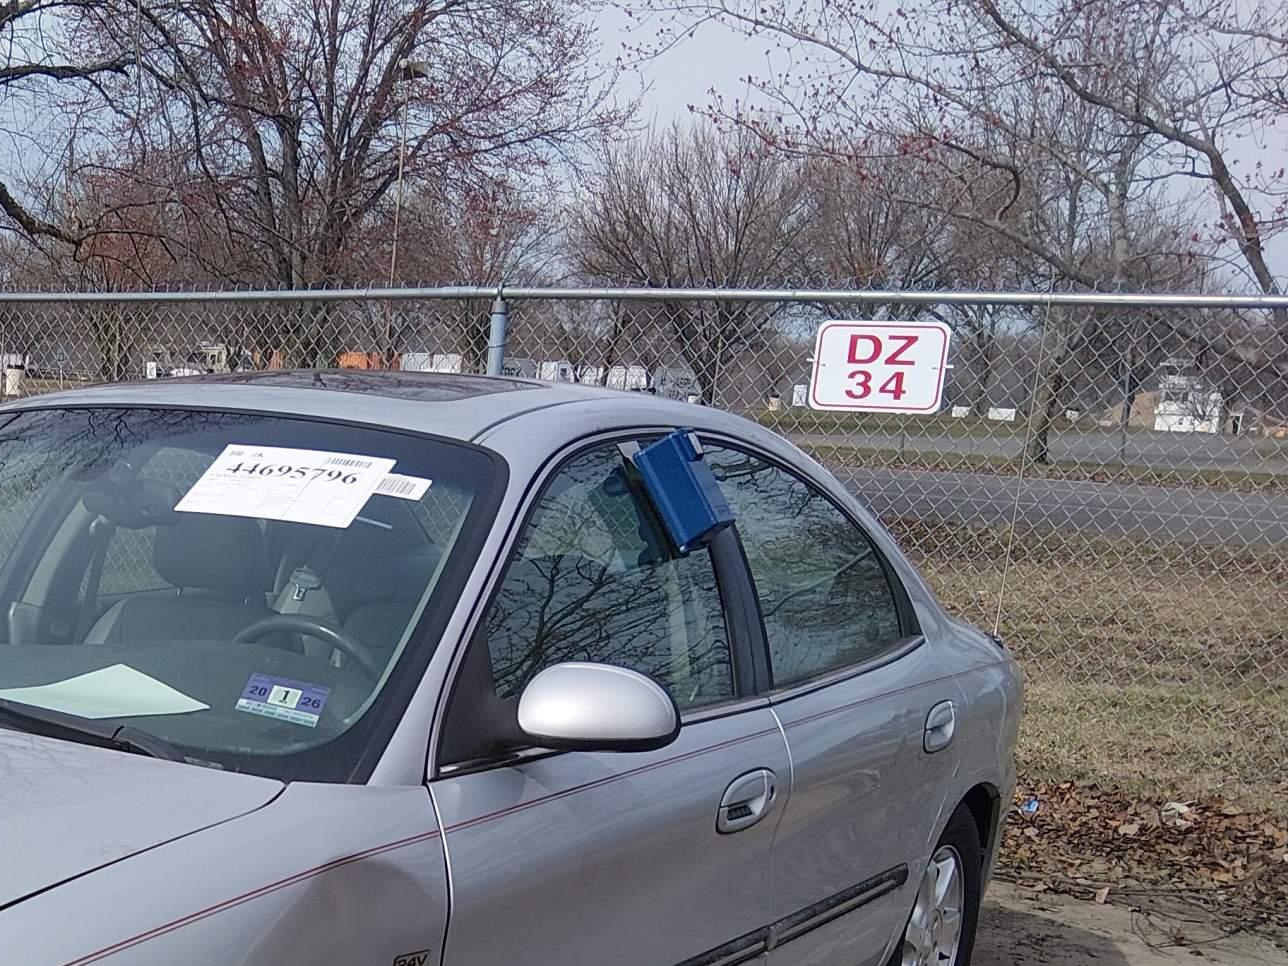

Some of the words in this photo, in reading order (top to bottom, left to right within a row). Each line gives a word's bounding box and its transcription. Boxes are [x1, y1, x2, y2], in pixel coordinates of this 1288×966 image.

[847, 334, 919, 366] DZ
[845, 370, 906, 400] 34
[225, 461, 361, 486] 44695796
[249, 685, 268, 697] 20
[282, 690, 291, 702] 1
[301, 697, 322, 709] 26
